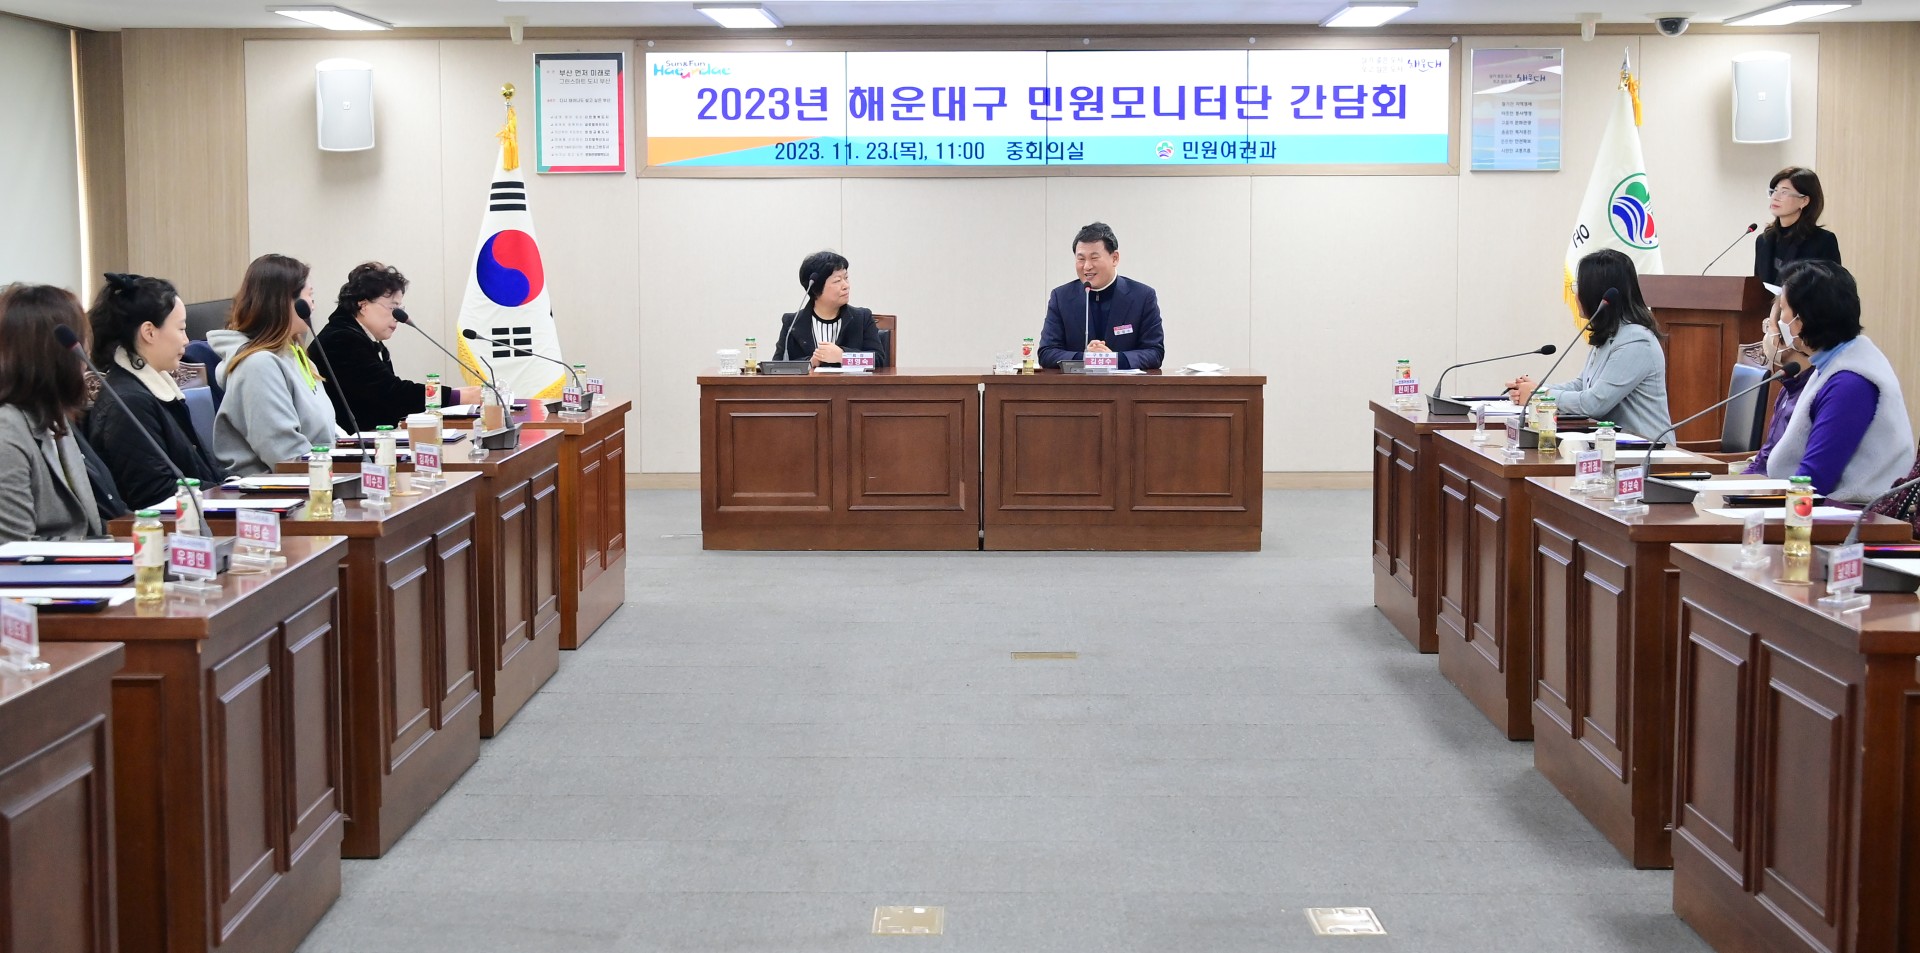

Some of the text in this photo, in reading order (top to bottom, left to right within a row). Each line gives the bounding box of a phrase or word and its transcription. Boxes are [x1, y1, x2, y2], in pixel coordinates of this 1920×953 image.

[559, 69, 573, 77] 부산
[574, 69, 588, 77] 먼저
[590, 69, 611, 77] 미래로
[698, 84, 1406, 121] 2023년 해운대구 민원모니터단 간담회
[775, 142, 825, 160] 2023.
[832, 142, 859, 160] 11.
[936, 142, 985, 160] 11:00
[1006, 141, 1084, 161] 중회의실
[1182, 140, 1277, 160] 민원여권과
